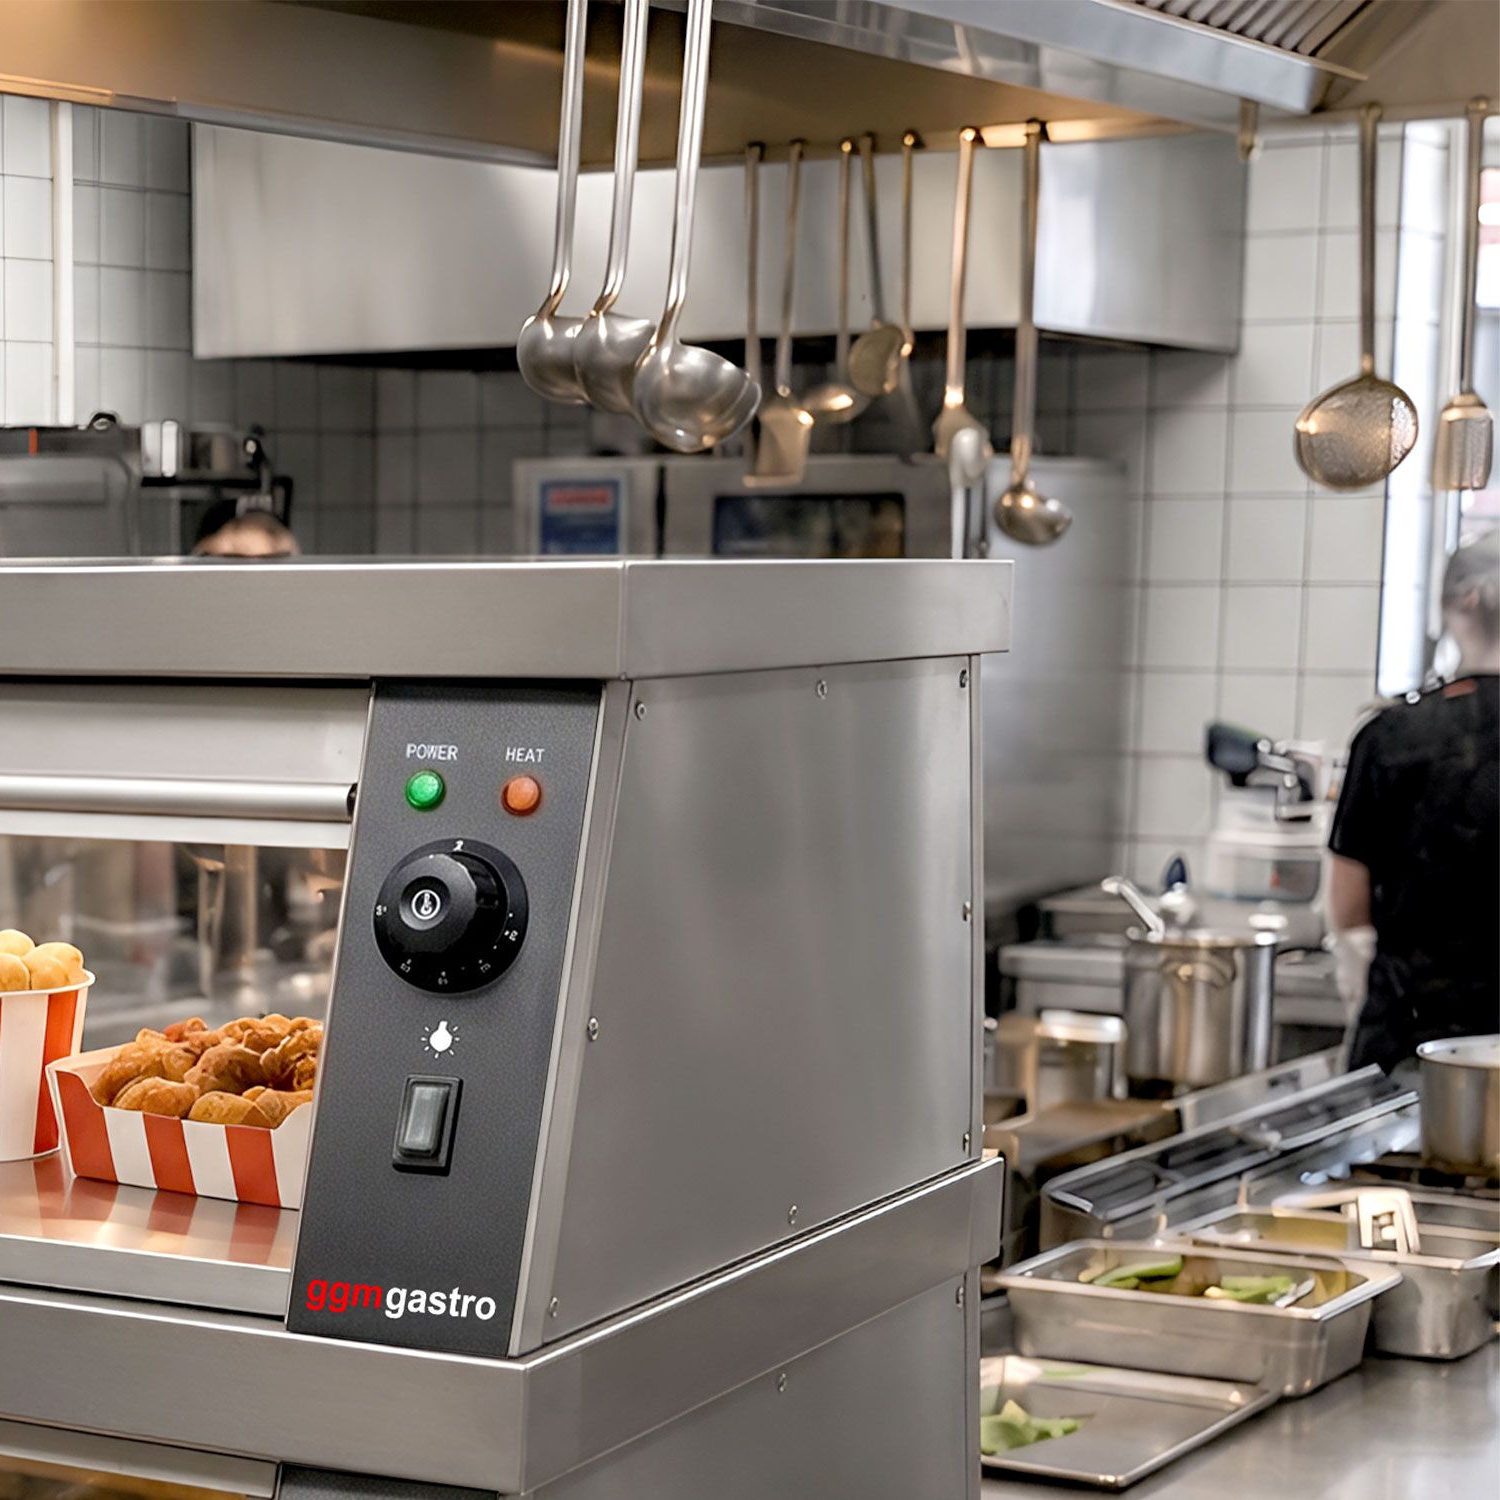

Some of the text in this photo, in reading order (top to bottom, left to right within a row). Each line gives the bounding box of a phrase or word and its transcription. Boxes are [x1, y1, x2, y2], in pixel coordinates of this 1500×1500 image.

[405, 743, 459, 761] POWER
[505, 746, 546, 763] HEAT
[306, 1279, 497, 1321] ggmgastro
